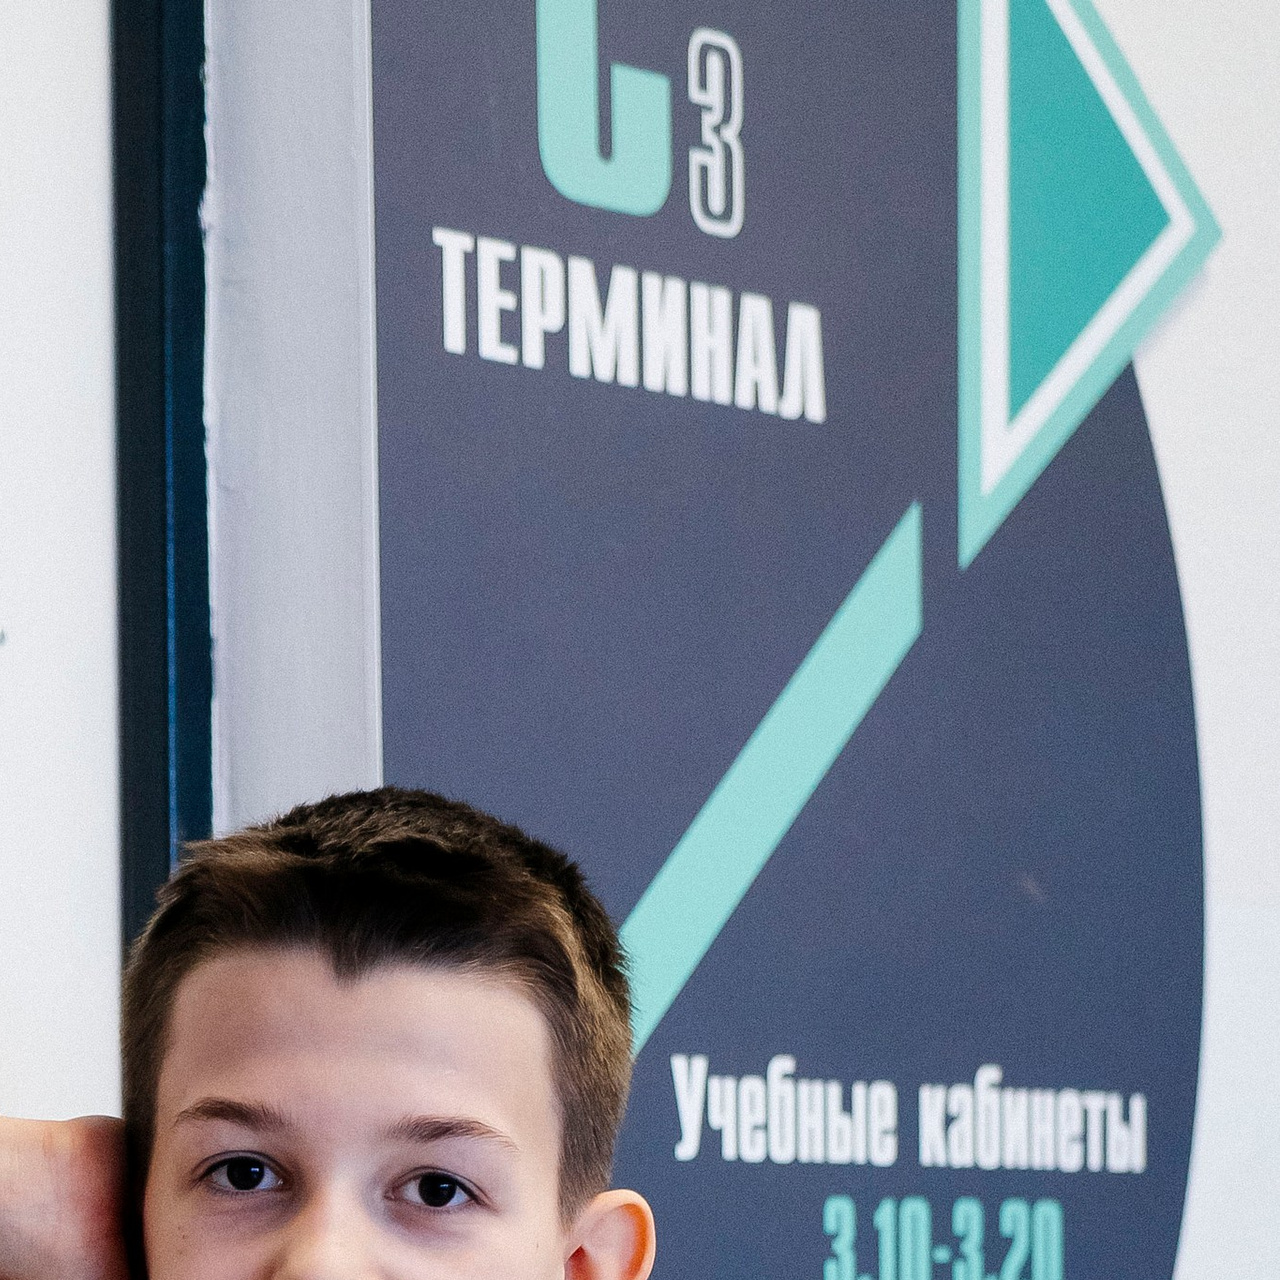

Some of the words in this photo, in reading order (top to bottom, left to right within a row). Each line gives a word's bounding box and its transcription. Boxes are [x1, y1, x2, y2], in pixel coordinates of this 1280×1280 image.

[432, 227, 827, 424] ТЕРМИНАЛ
[670, 1053, 898, 1167] Учебные
[919, 1063, 1148, 1174] кабинеты
